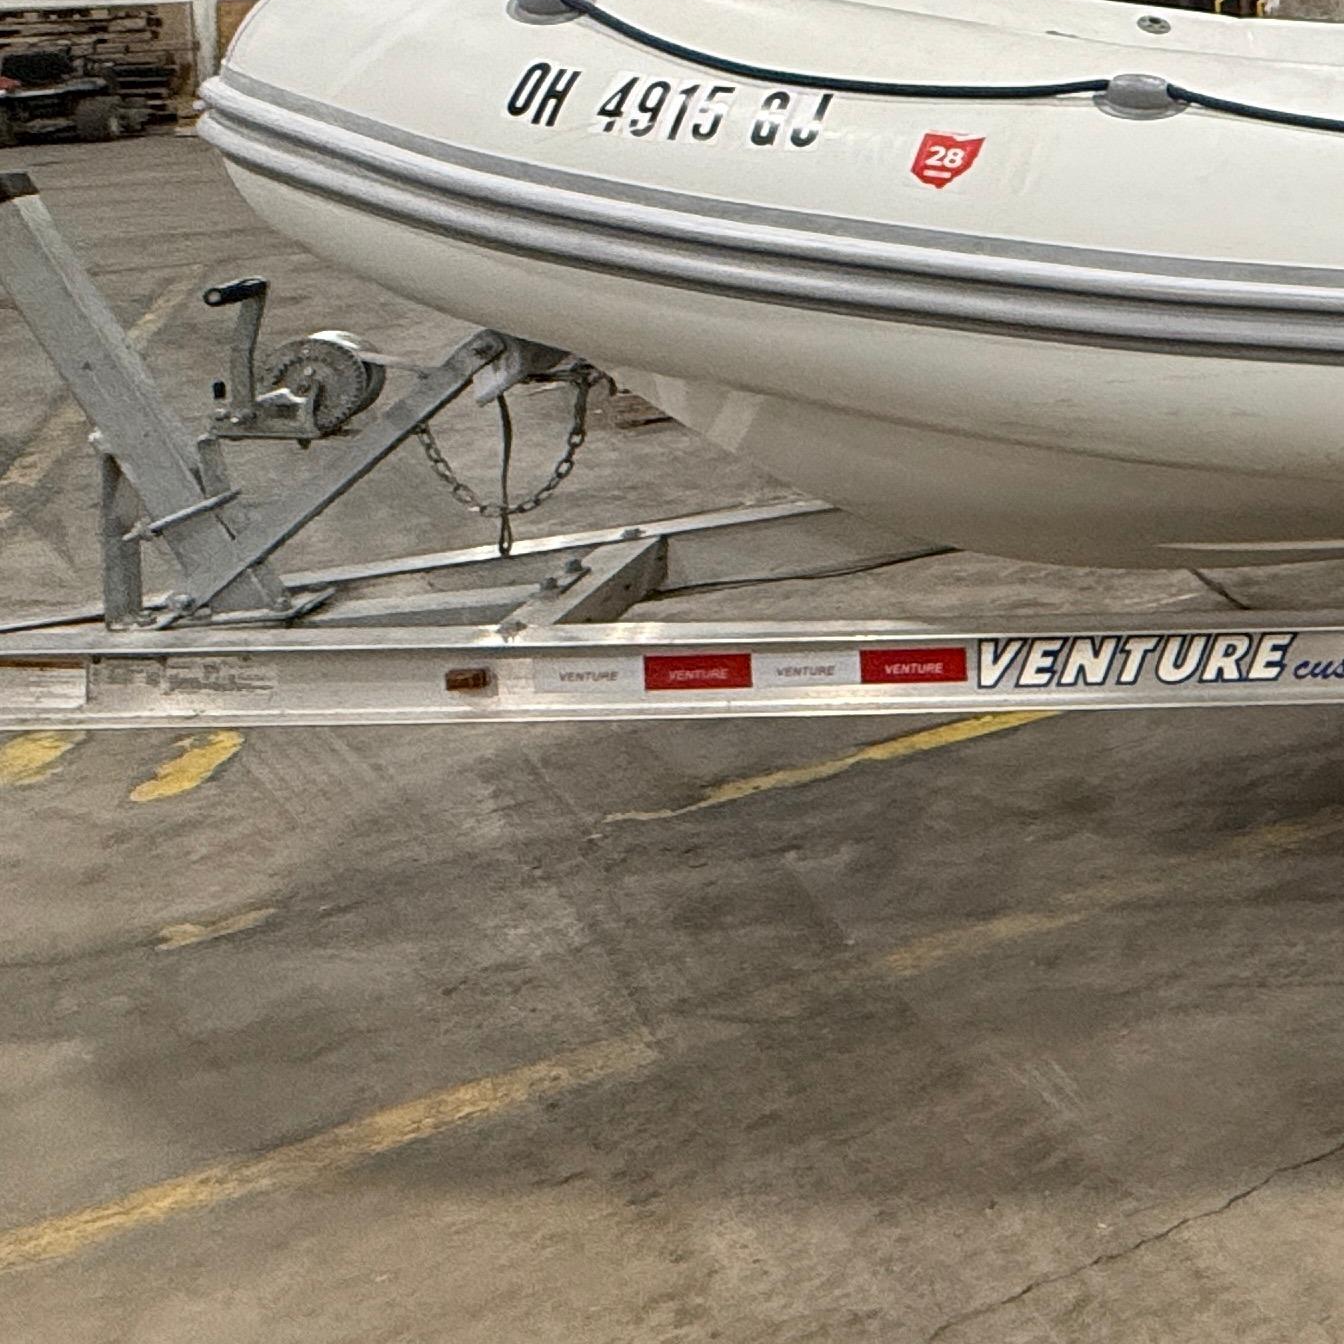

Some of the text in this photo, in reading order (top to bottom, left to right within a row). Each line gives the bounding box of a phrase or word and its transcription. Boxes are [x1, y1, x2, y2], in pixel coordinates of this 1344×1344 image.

[507, 62, 582, 127] OH
[597, 76, 736, 142] 4915
[924, 144, 965, 169] 28
[977, 632, 1298, 688] VENTURE
[668, 667, 729, 681] VENTURE
[775, 664, 835, 678] VENTURE
[884, 661, 944, 675] VENTURE
[558, 670, 618, 683] VENTURE
